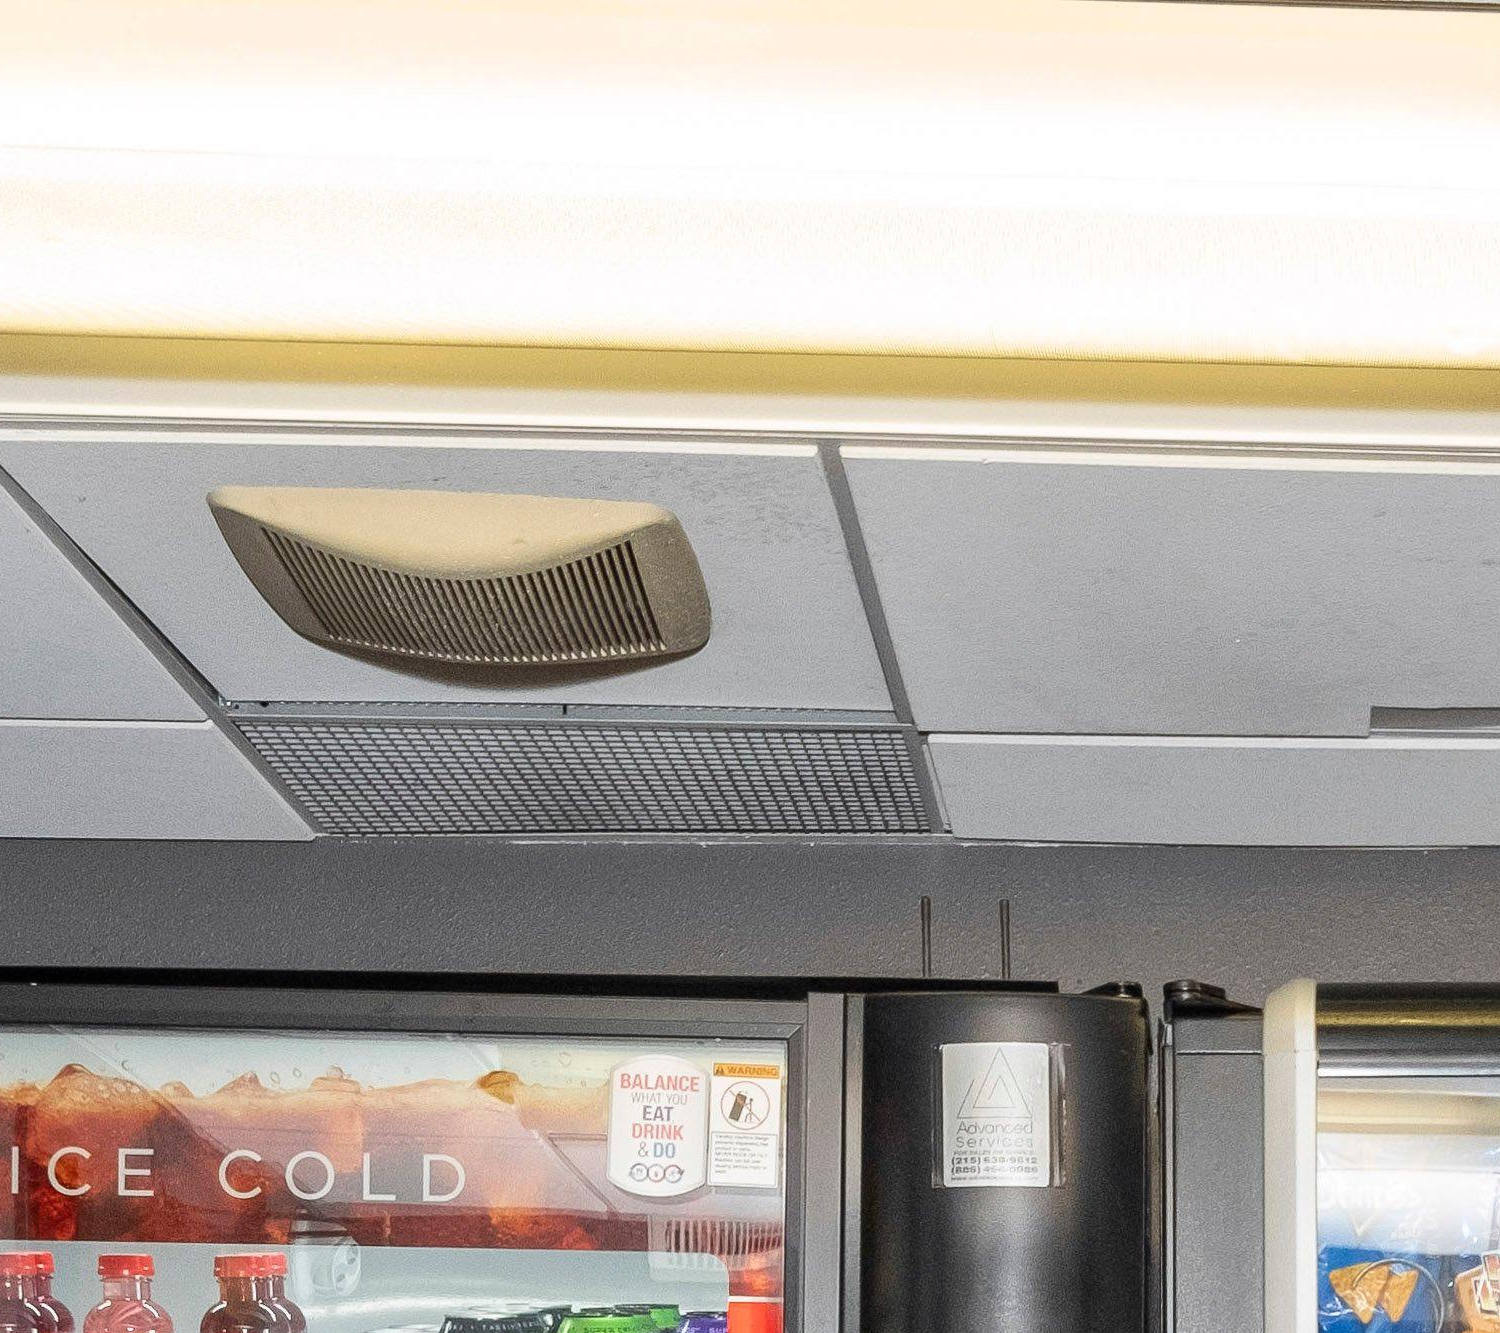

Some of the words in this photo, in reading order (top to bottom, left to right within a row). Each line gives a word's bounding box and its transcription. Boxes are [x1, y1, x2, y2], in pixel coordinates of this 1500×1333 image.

[728, 1066, 778, 1076] WARNING
[620, 1073, 700, 1092] BALANCE
[631, 1093, 662, 1103] WHAT
[666, 1094, 688, 1105] YOU
[642, 1106, 673, 1121] EAT
[632, 1123, 683, 1140] DRINK
[957, 1121, 1033, 1134] Advanced
[638, 1142, 648, 1158] &
[654, 1142, 676, 1158] DO
[955, 1137, 1034, 1148] Services
[10, 1147, 155, 1197] ICE
[219, 1150, 467, 1203] COLD
